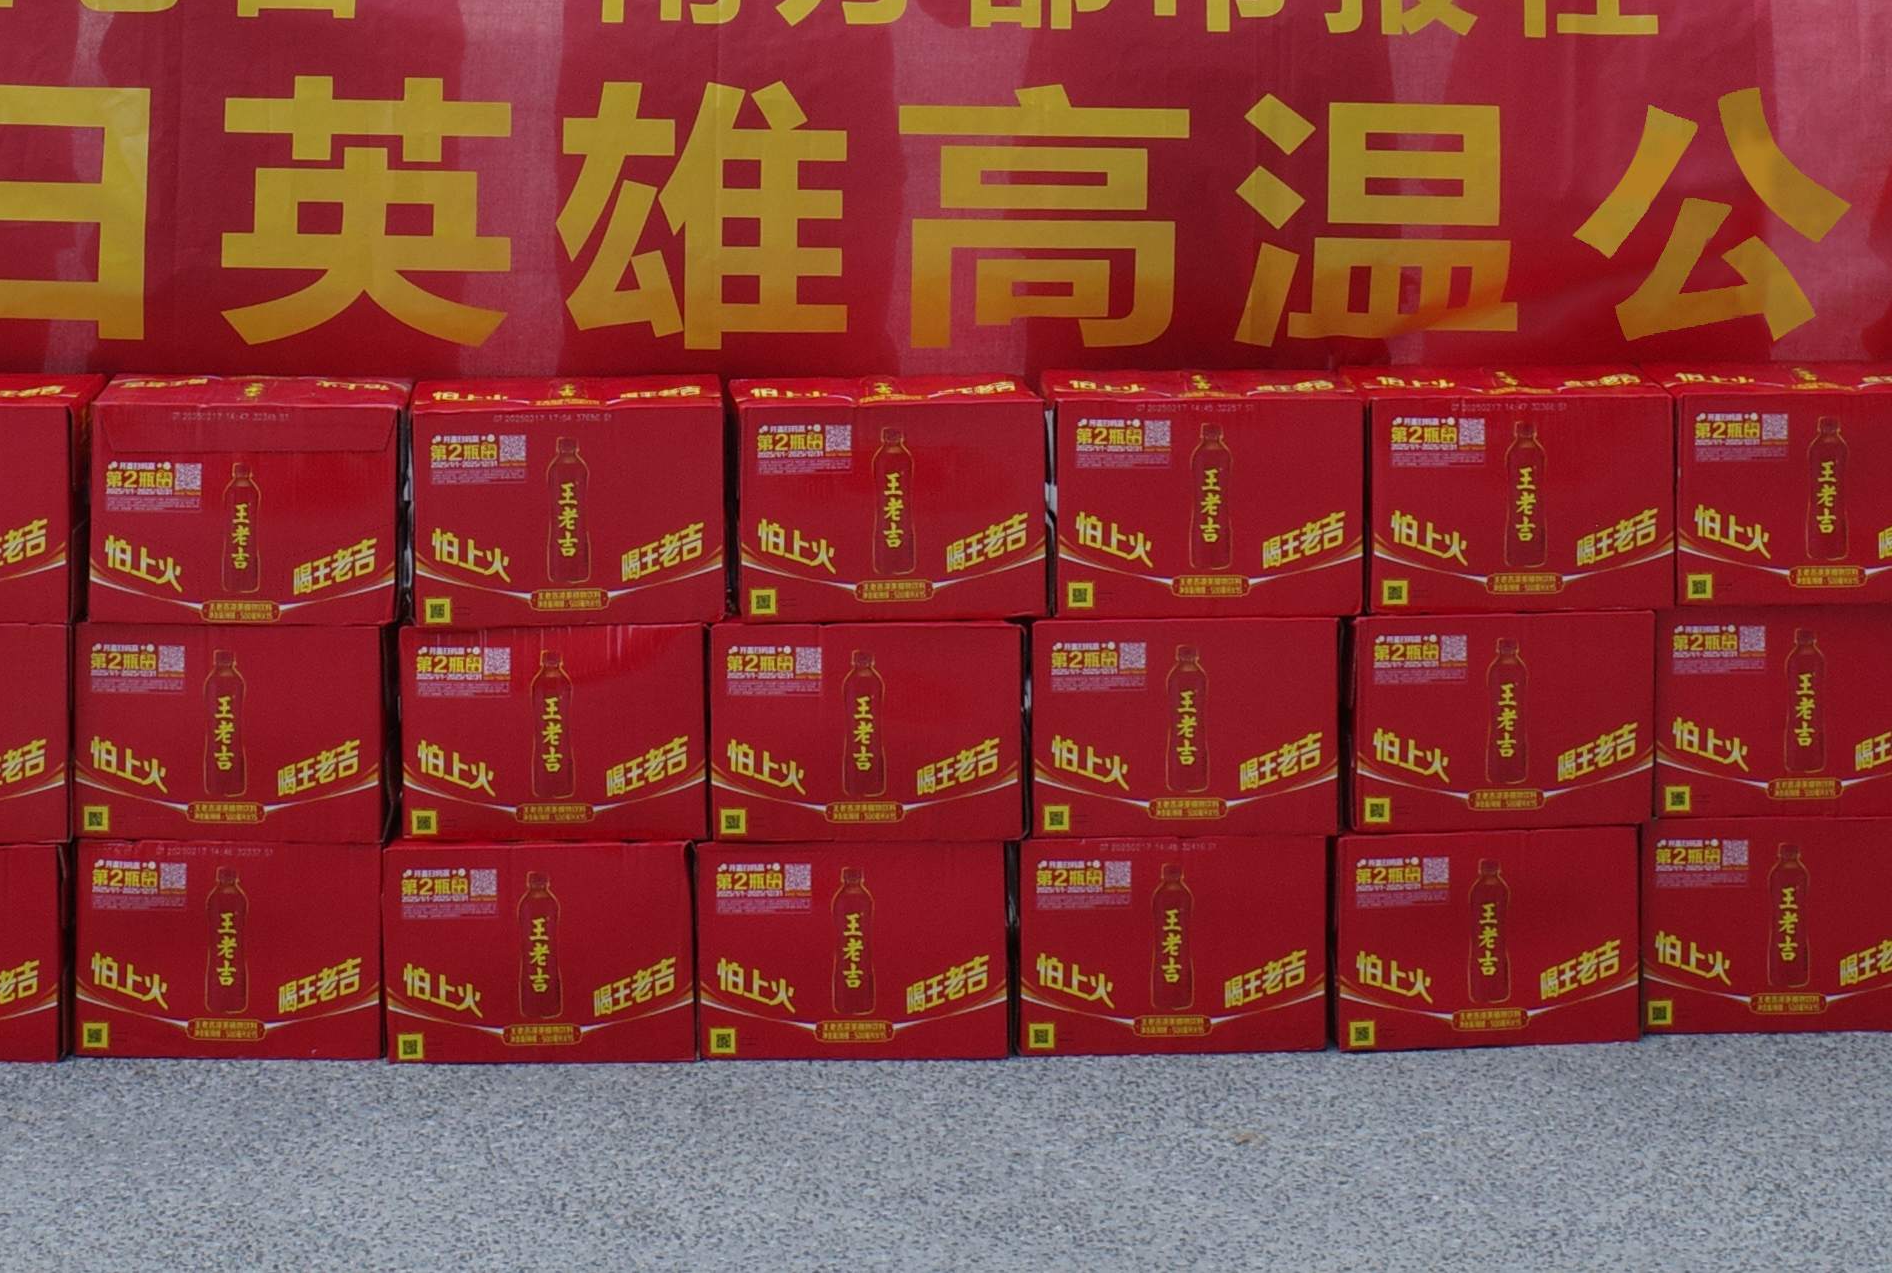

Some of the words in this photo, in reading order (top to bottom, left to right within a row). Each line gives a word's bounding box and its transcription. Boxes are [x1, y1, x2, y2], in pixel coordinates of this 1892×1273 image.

[557, 482, 578, 557] 王老吉
[883, 472, 904, 548] 王老吉
[1200, 468, 1221, 543] 王老吉
[1515, 467, 1537, 541] 王老吉
[1816, 461, 1837, 533] 王老吉
[231, 503, 250, 569] 王老吉
[432, 528, 511, 583] 怕上火
[621, 522, 704, 582] 喝王老吉
[757, 518, 836, 574] 怕上火
[946, 512, 1028, 573] 喝王老吉
[1075, 511, 1153, 568] 怕上火
[1262, 511, 1345, 569] 喝王老吉
[1391, 510, 1468, 565] 怕上火
[1576, 508, 1658, 566] 喝王老吉
[1694, 504, 1771, 559] 怕上火
[104, 534, 182, 593] 怕上火
[293, 538, 377, 595] 喝王老吉
[214, 696, 235, 770] 王老吉
[542, 697, 563, 772] 王老吉
[853, 696, 874, 770] 王老吉
[1176, 690, 1197, 765] 王老吉
[1497, 683, 1517, 757] 王老吉
[1794, 673, 1815, 746] 王老吉
[90, 736, 167, 793] 怕上火
[277, 739, 360, 796] 喝王老吉
[417, 740, 495, 796] 怕上火
[606, 736, 688, 797] 喝王老吉
[727, 739, 806, 795] 怕上火
[917, 738, 1000, 795] 喝王老吉
[1051, 735, 1129, 790] 怕上火
[1239, 732, 1322, 791] 喝王老吉
[1373, 728, 1449, 783] 怕上火
[1557, 722, 1637, 782] 喝王老吉
[1673, 717, 1749, 772] 怕上火
[217, 912, 237, 986] 王老吉
[843, 913, 864, 988] 王老吉
[1162, 909, 1182, 982] 王老吉
[1478, 903, 1498, 975] 王老吉
[1778, 887, 1798, 961] 王老吉
[91, 952, 168, 1009] 怕上火
[529, 917, 550, 992] 王老吉
[1036, 953, 1114, 1008] 怕上火
[1224, 950, 1307, 1008] 喝王老吉
[1356, 951, 1432, 1003] 怕上火
[1540, 940, 1620, 1000] 喝王老吉
[1655, 931, 1731, 984] 怕上火
[278, 957, 362, 1014] 喝王老吉
[403, 963, 482, 1017] 怕上火
[594, 957, 676, 1016] 喝王老吉
[717, 957, 795, 1013] 怕上火
[906, 955, 989, 1014] 喝王老吉
